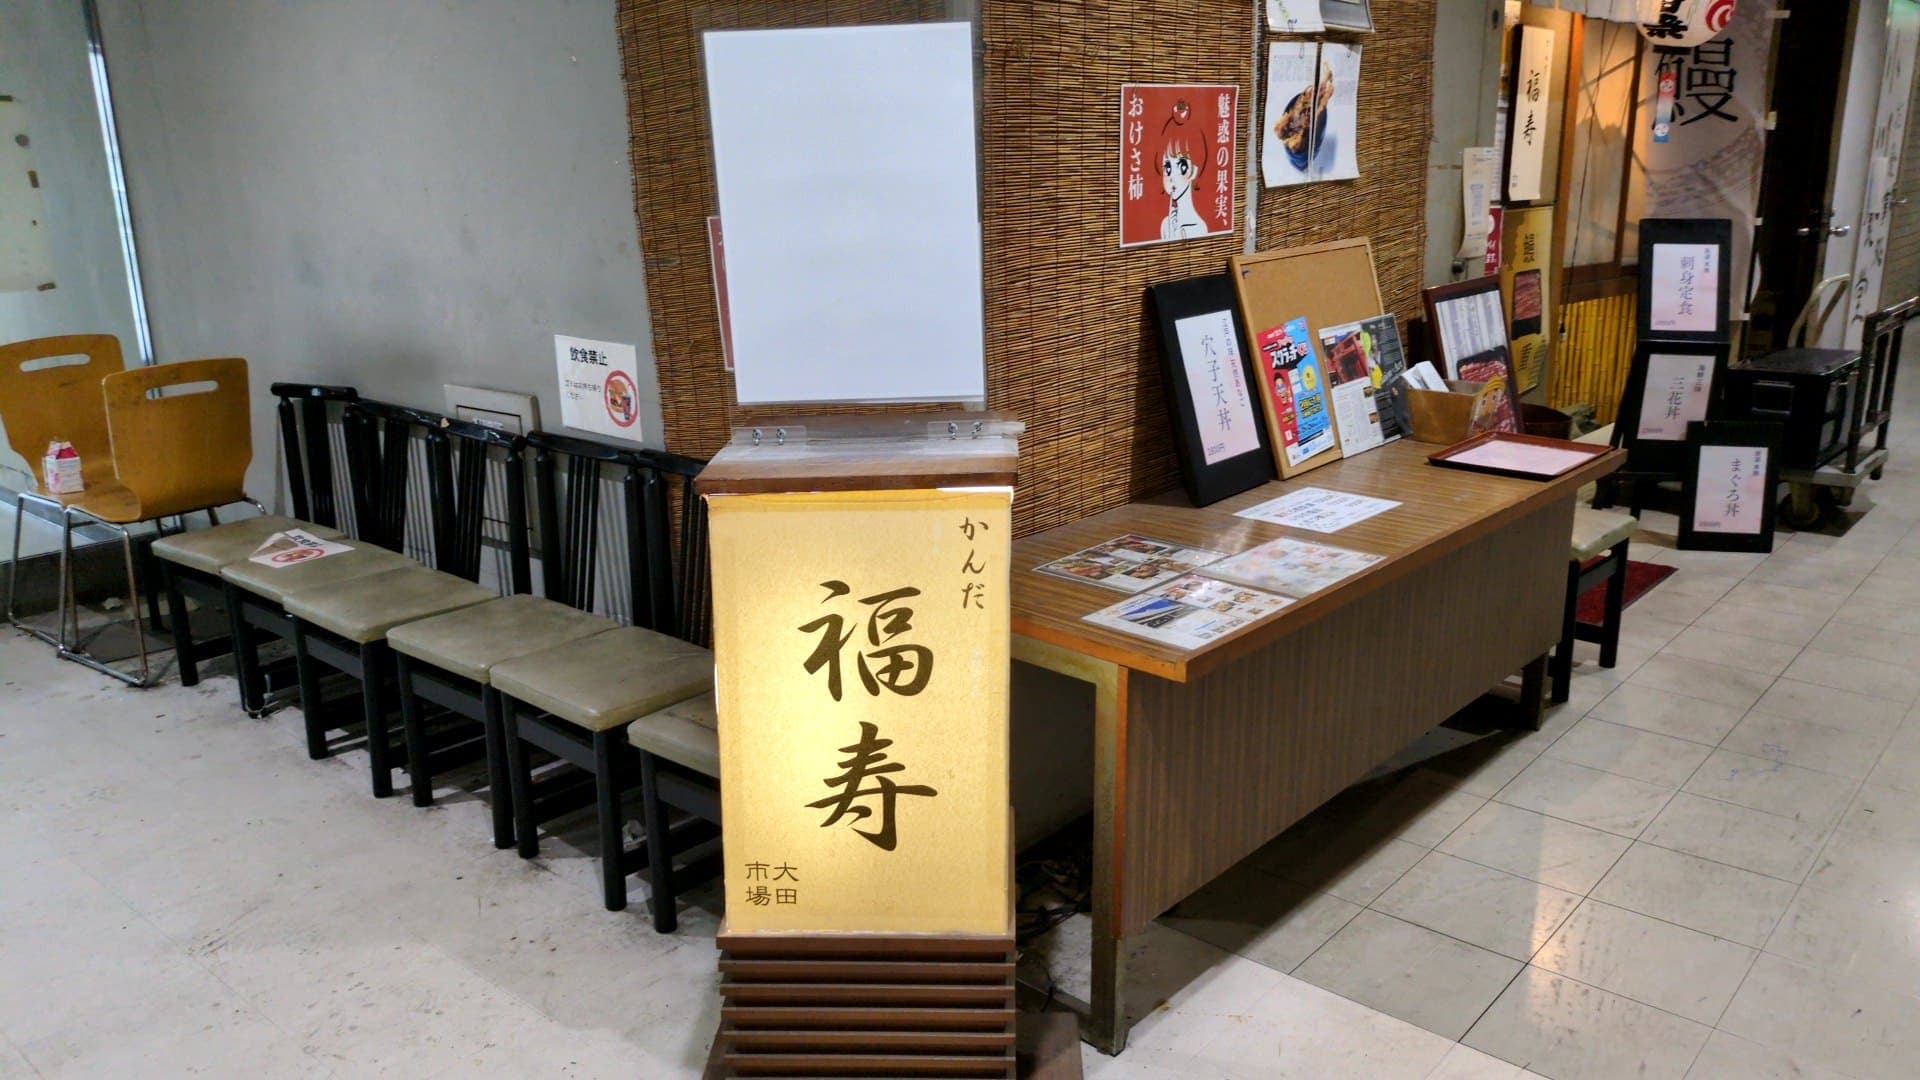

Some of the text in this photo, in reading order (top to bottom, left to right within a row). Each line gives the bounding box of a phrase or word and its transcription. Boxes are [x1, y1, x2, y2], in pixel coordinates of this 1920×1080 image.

[1128, 93, 1144, 200] おけさ柿
[570, 347, 608, 366] 飲食禁止
[1724, 458, 1742, 518] まぐろ丼
[959, 516, 989, 610] かんだ
[798, 580, 938, 852] 福寿
[745, 861, 771, 906] 市場
[773, 861, 798, 905] 大田
